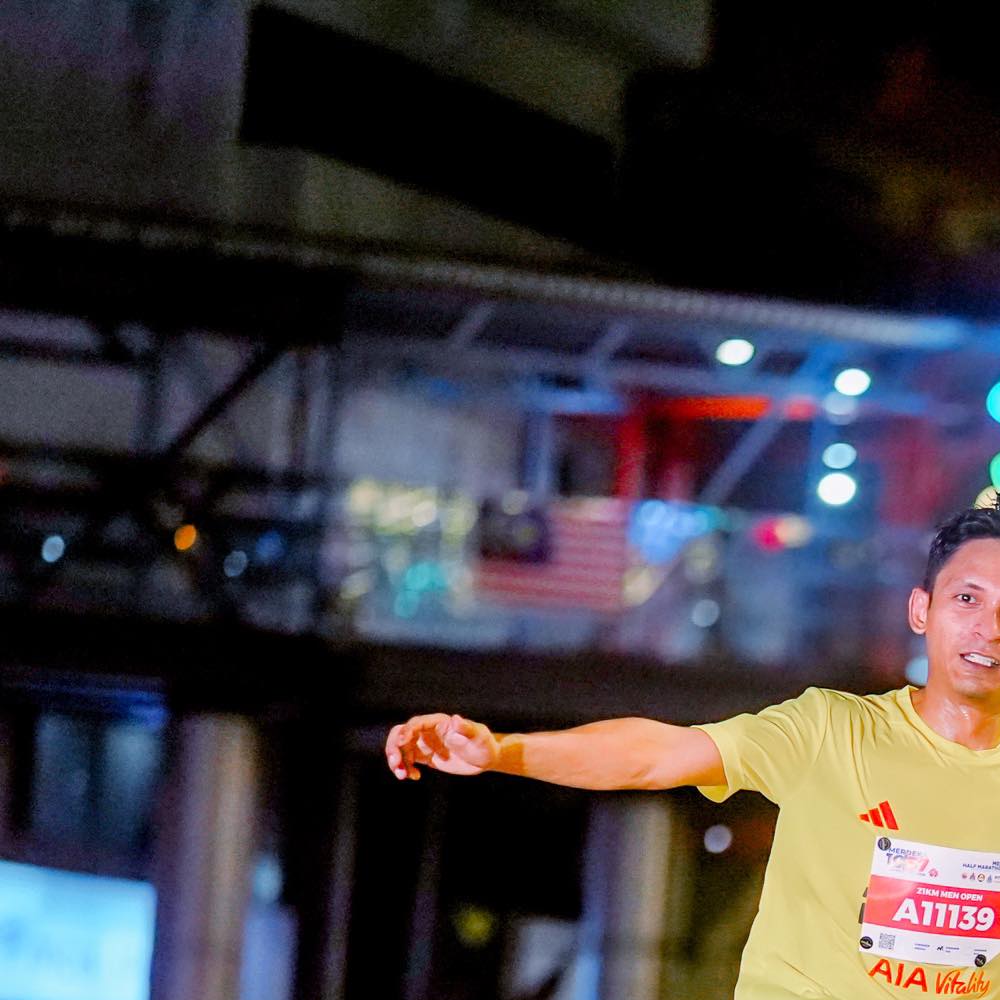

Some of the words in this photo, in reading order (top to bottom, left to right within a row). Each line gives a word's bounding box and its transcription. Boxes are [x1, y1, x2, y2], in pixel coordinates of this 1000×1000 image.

[916, 887, 940, 897] 21KM
[940, 891, 960, 899] MEN
[960, 893, 983, 902] OPEN
[892, 898, 995, 932] A11139
[868, 958, 928, 993] AIA
[935, 969, 991, 999] Vitality
